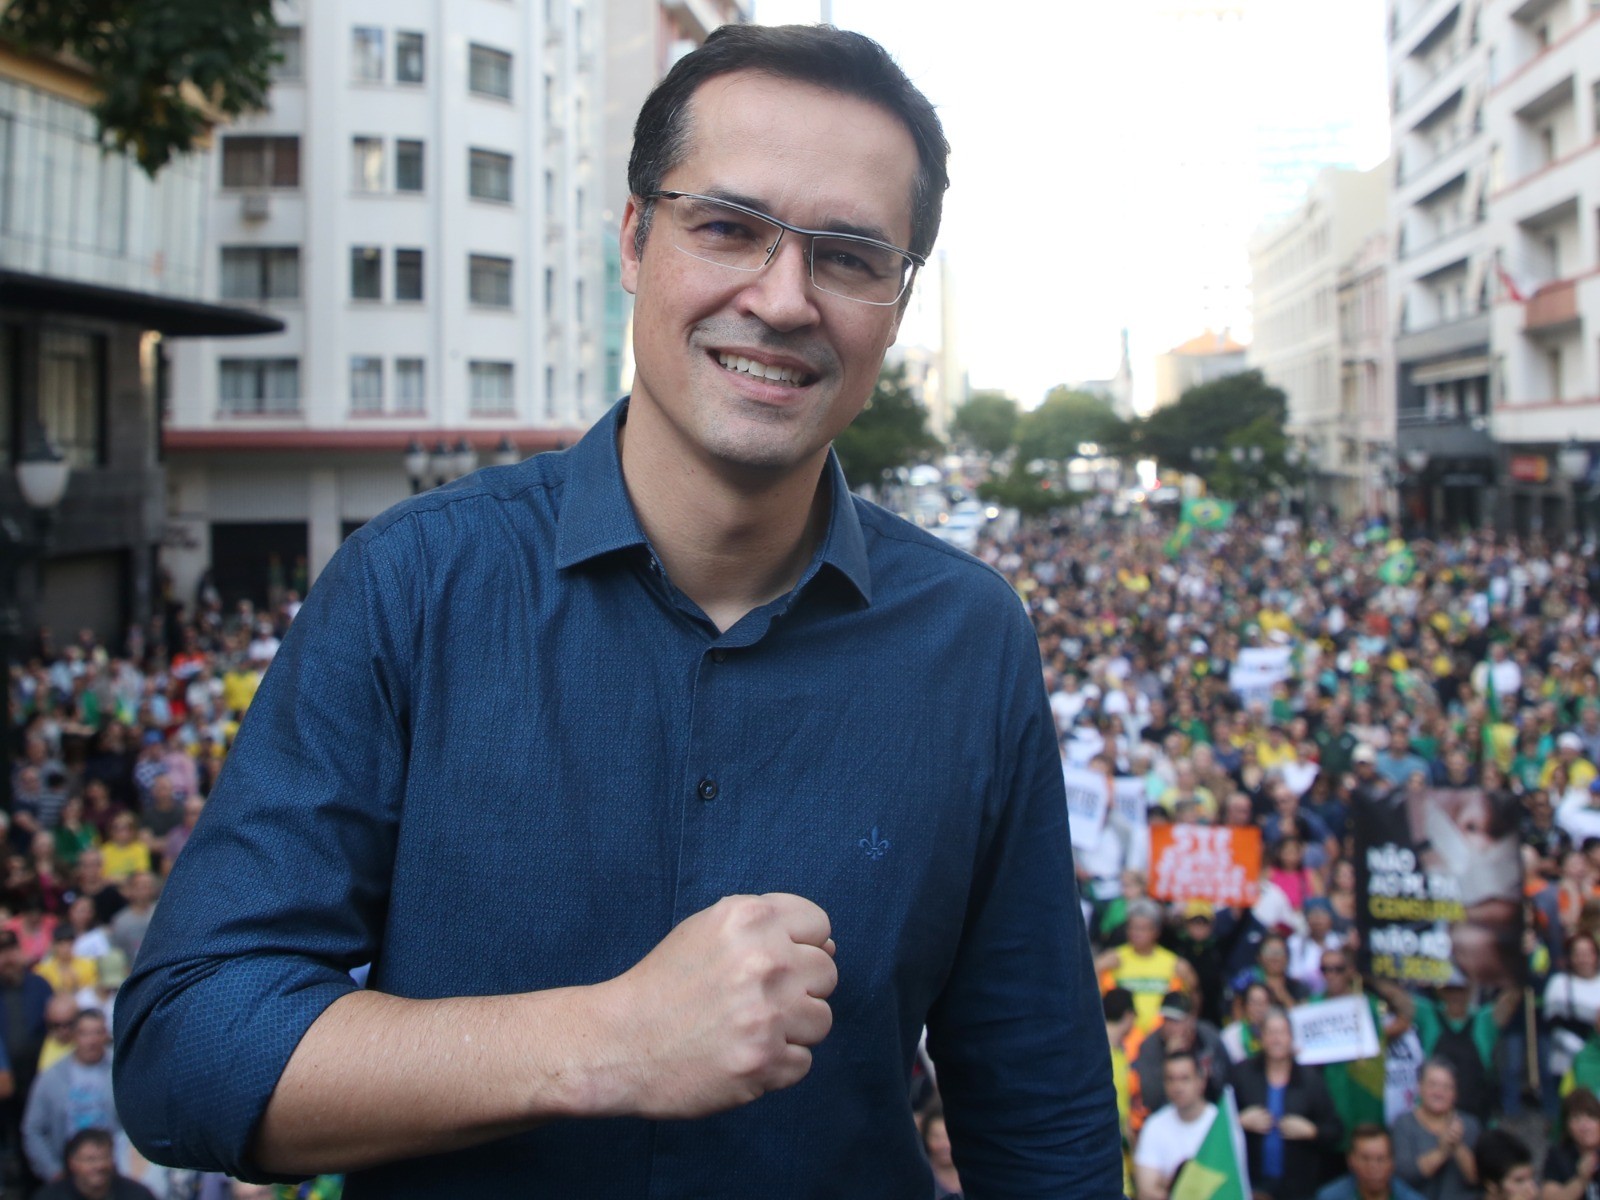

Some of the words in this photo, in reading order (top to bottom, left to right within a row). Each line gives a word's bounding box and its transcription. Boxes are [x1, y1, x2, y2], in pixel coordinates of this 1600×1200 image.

[1366, 842, 1416, 873] NÃO
[1368, 873, 1400, 897] AO
[1369, 895, 1467, 922] CENSURA
[1370, 924, 1419, 956] NÃO
